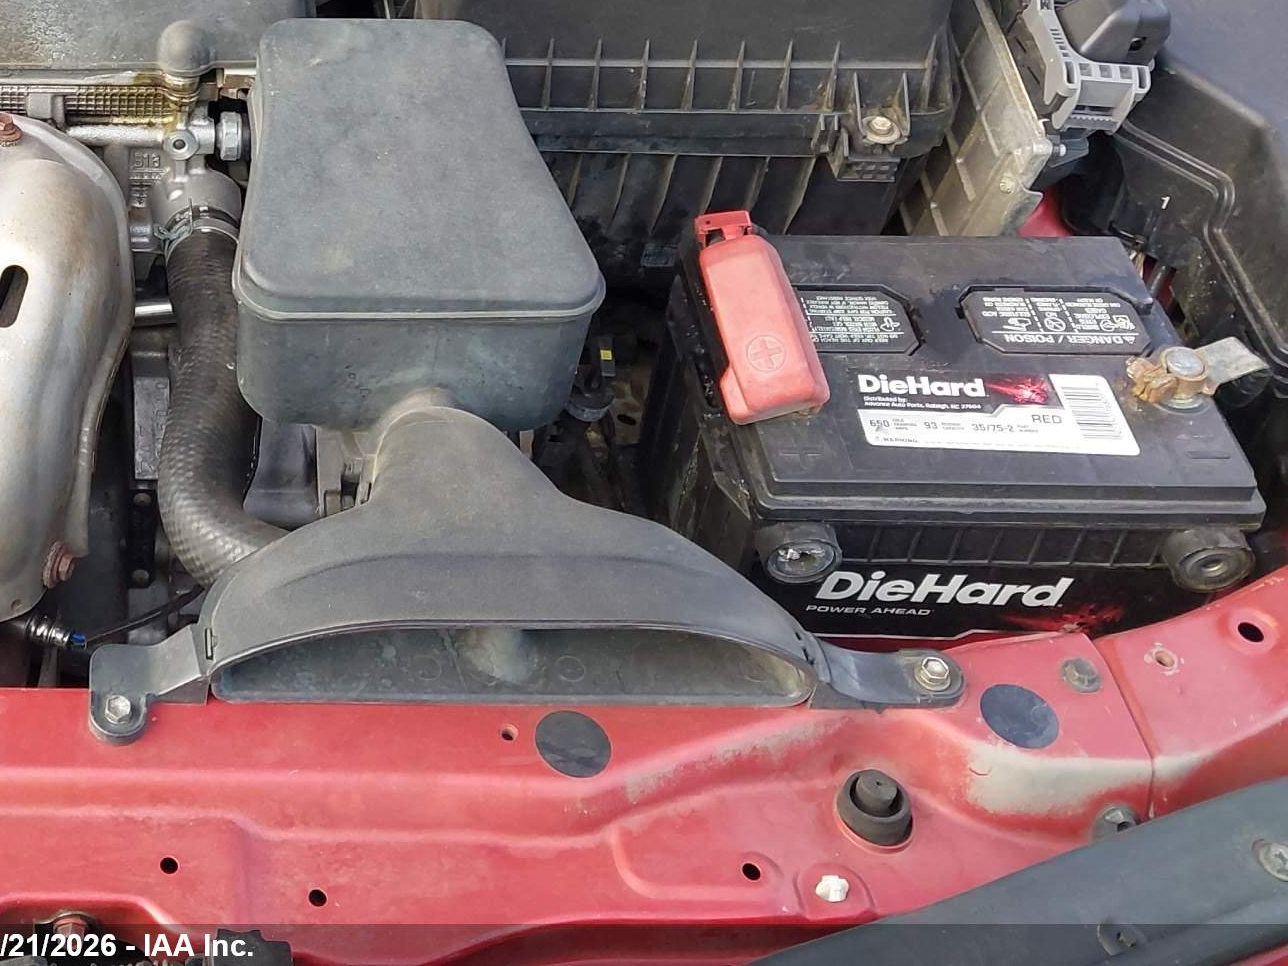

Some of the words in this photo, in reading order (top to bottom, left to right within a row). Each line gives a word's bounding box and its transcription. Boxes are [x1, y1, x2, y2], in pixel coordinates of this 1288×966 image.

[1003, 334, 1056, 344] POISON
[1068, 334, 1124, 344] DANGER
[857, 374, 986, 398] DieHard
[869, 418, 890, 428] 650
[924, 421, 939, 430] 93
[971, 423, 1015, 433] 35/75-2
[1031, 414, 1062, 425] RED
[815, 570, 1075, 607] DieHard
[806, 604, 868, 615] POWER
[870, 607, 931, 616] AHEAD
